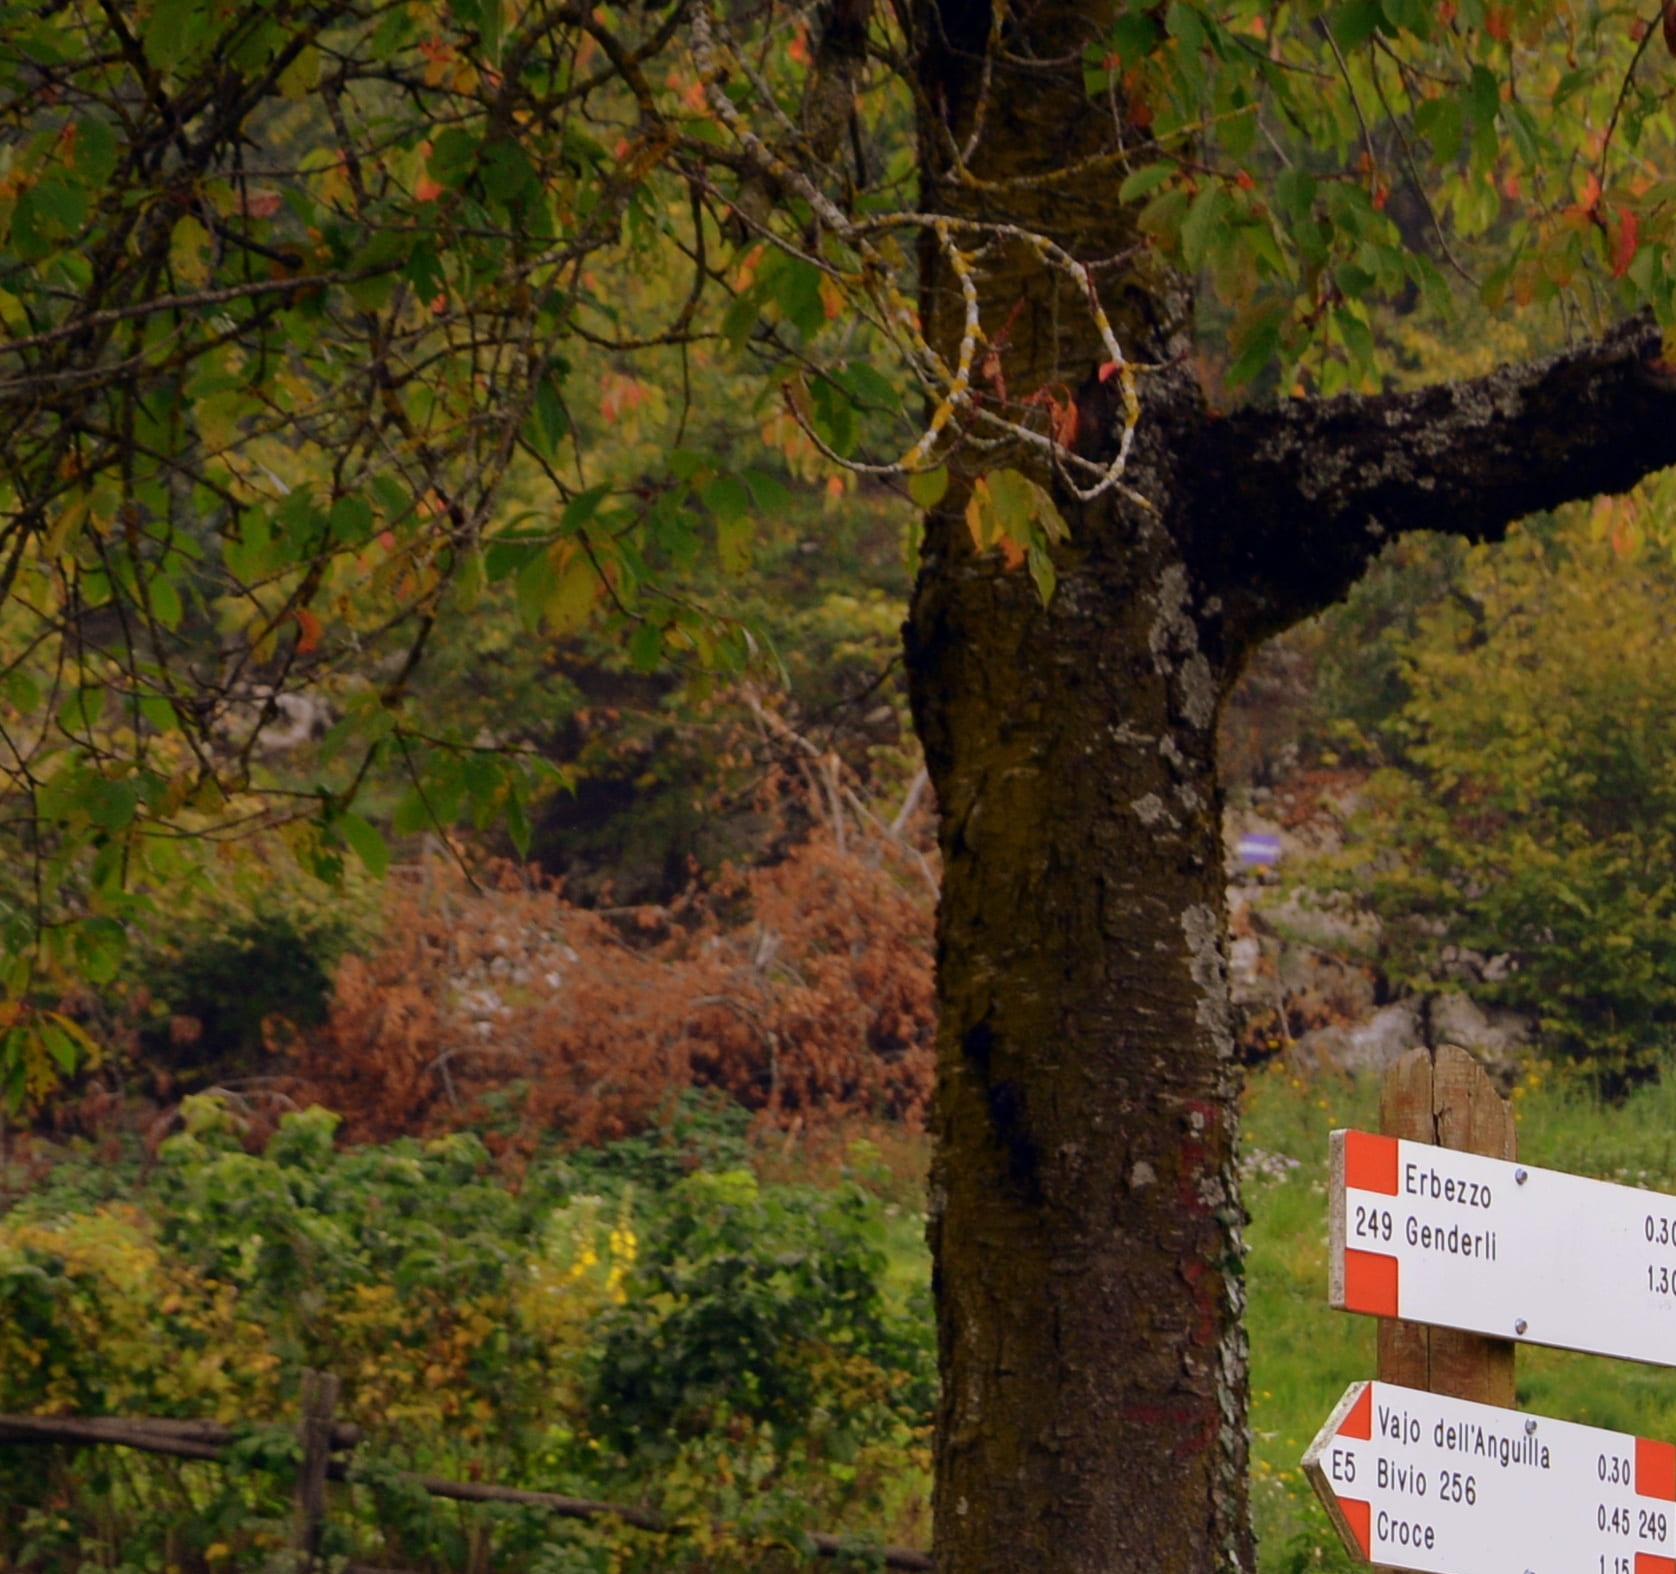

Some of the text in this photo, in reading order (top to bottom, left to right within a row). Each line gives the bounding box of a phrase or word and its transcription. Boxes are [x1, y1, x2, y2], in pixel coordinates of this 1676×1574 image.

[1405, 1163, 1492, 1209] Erbezzo
[1356, 1206, 1393, 1241] 249
[1405, 1216, 1496, 1261] Genderli
[1378, 1405, 1631, 1486] Vajo dell'Anguilla 0.30
[1332, 1450, 1667, 1542] E5 Bivio 256 0.45 249
[1377, 1510, 1435, 1550] Croce
